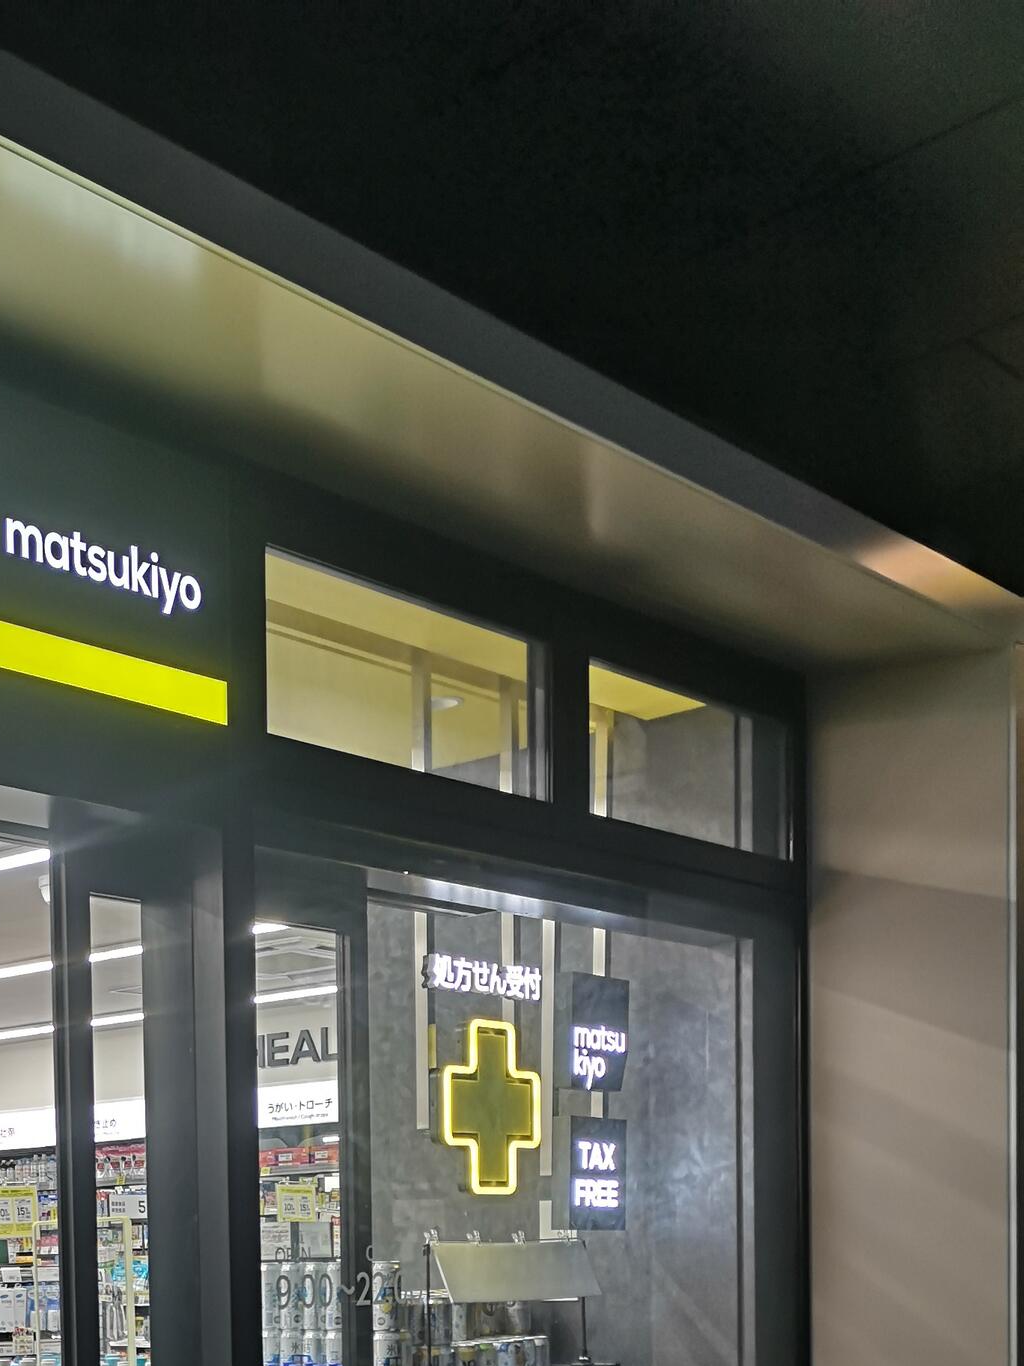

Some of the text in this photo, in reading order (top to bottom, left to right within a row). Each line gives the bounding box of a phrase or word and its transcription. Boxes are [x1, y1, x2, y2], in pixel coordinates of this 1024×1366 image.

[5, 516, 202, 614] matsukiyo
[431, 953, 542, 1002] 処方せん受付
[573, 1026, 626, 1054] matsu
[573, 1052, 607, 1090] kiyo
[578, 1141, 616, 1171] TAX
[138, 1200, 147, 1214] 5
[575, 1179, 619, 1208] FREE
[275, 1247, 311, 1261] OPN
